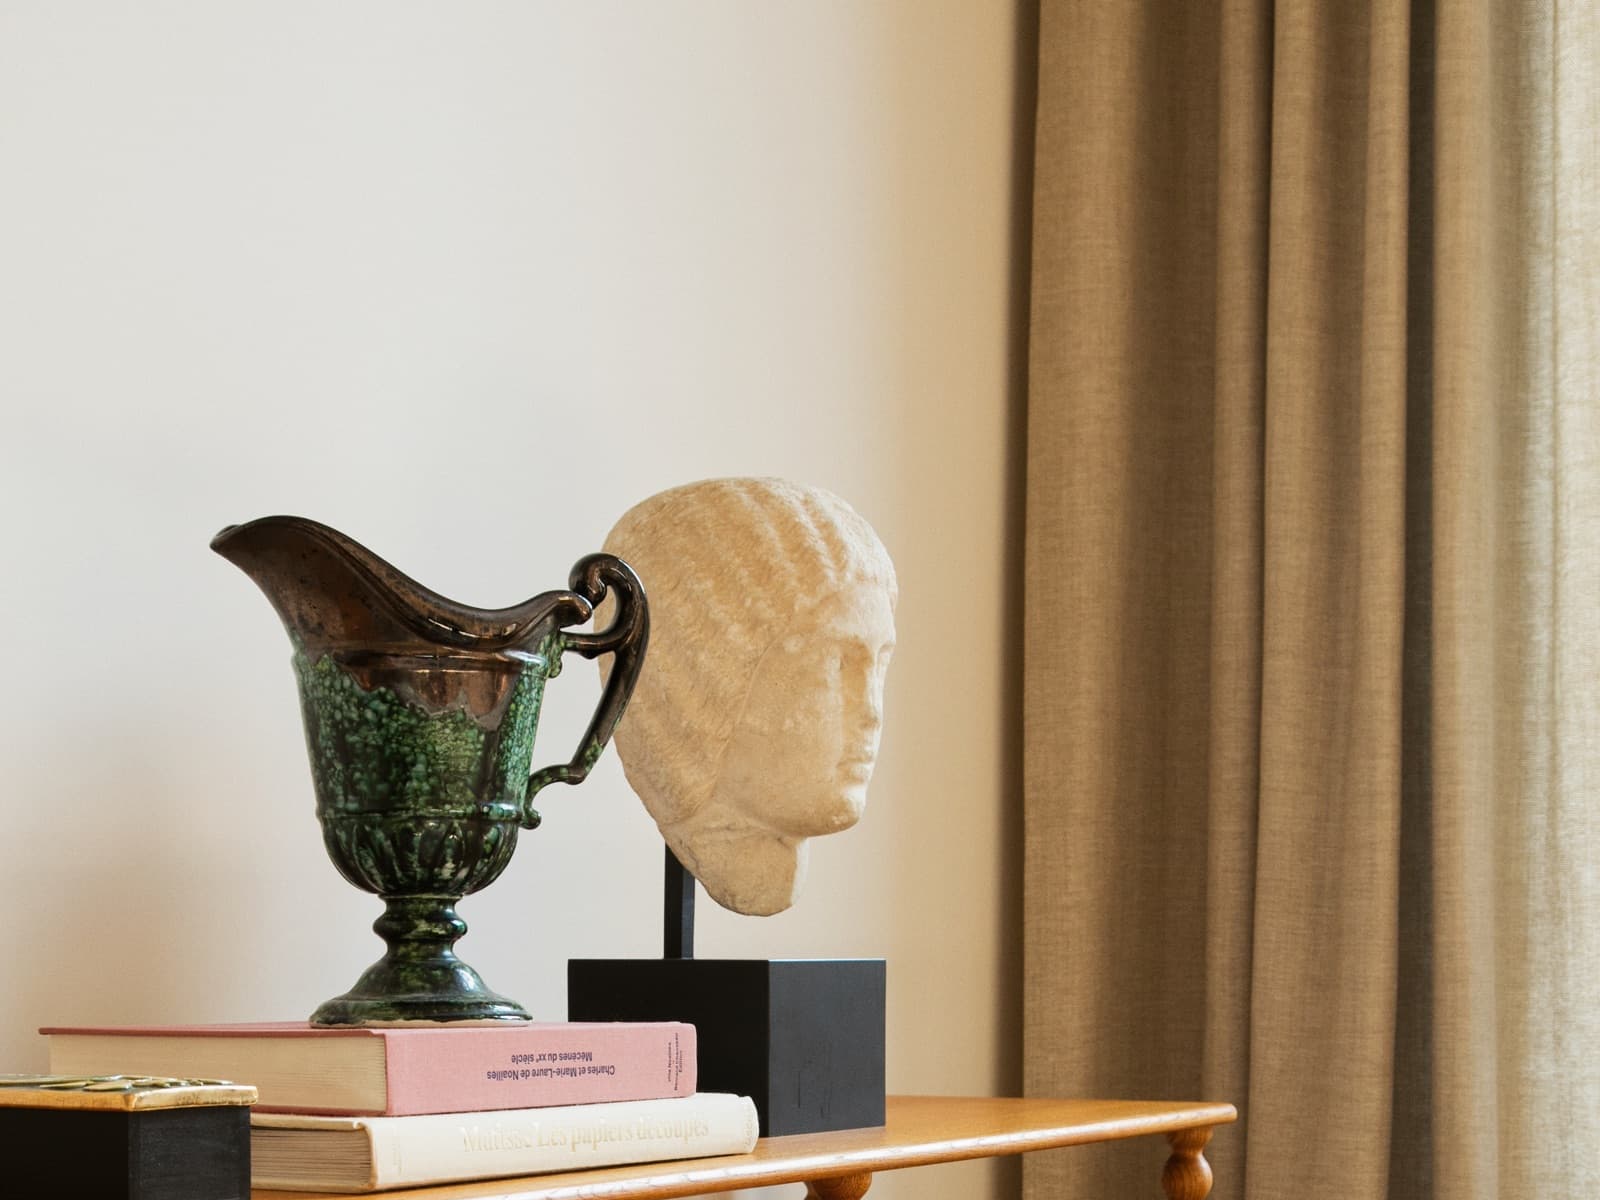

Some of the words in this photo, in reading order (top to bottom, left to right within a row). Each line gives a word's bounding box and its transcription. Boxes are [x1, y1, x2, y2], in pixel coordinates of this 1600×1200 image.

[511, 1053, 534, 1066] siècle
[547, 1053, 558, 1064] du
[559, 1051, 593, 1063] Mécènes
[487, 1070, 520, 1081] Noailles
[520, 1069, 530, 1081] de
[532, 1067, 578, 1080] Marie-Laure
[578, 1067, 586, 1077] et
[587, 1064, 616, 1077] Charles
